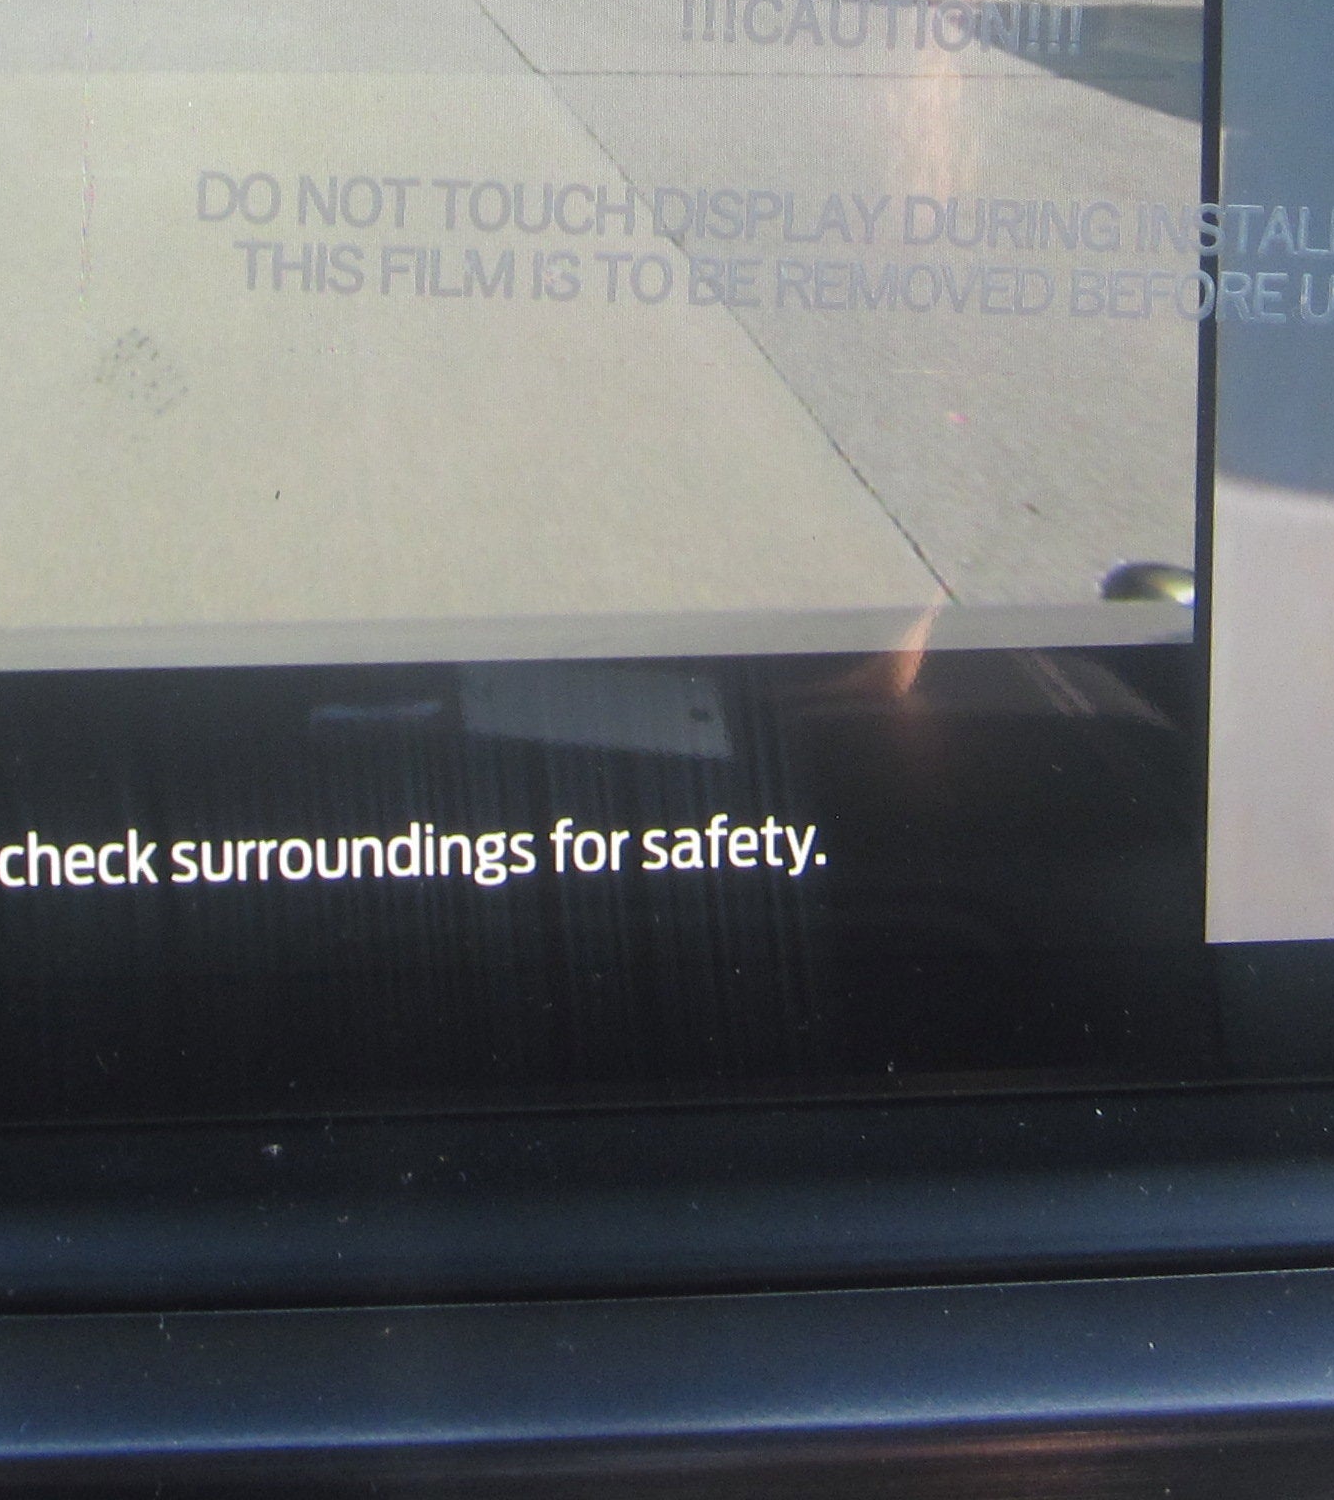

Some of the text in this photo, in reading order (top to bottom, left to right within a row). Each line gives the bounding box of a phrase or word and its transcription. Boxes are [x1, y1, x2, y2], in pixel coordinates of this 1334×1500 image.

[196, 171, 281, 225] DO
[297, 175, 421, 230] NOT
[432, 179, 635, 238] TOUCH
[652, 187, 893, 244] DISPLAY
[902, 195, 1121, 252] DURING
[233, 240, 365, 295] THIS
[379, 246, 515, 299] FILM
[594, 251, 673, 305] TO
[688, 256, 761, 308] BE
[776, 259, 1054, 314] REMOVED
[1069, 268, 1287, 323] BEFORE
[169, 822, 535, 887] surroundings
[547, 817, 629, 871] for
[640, 814, 827, 876] safety.
